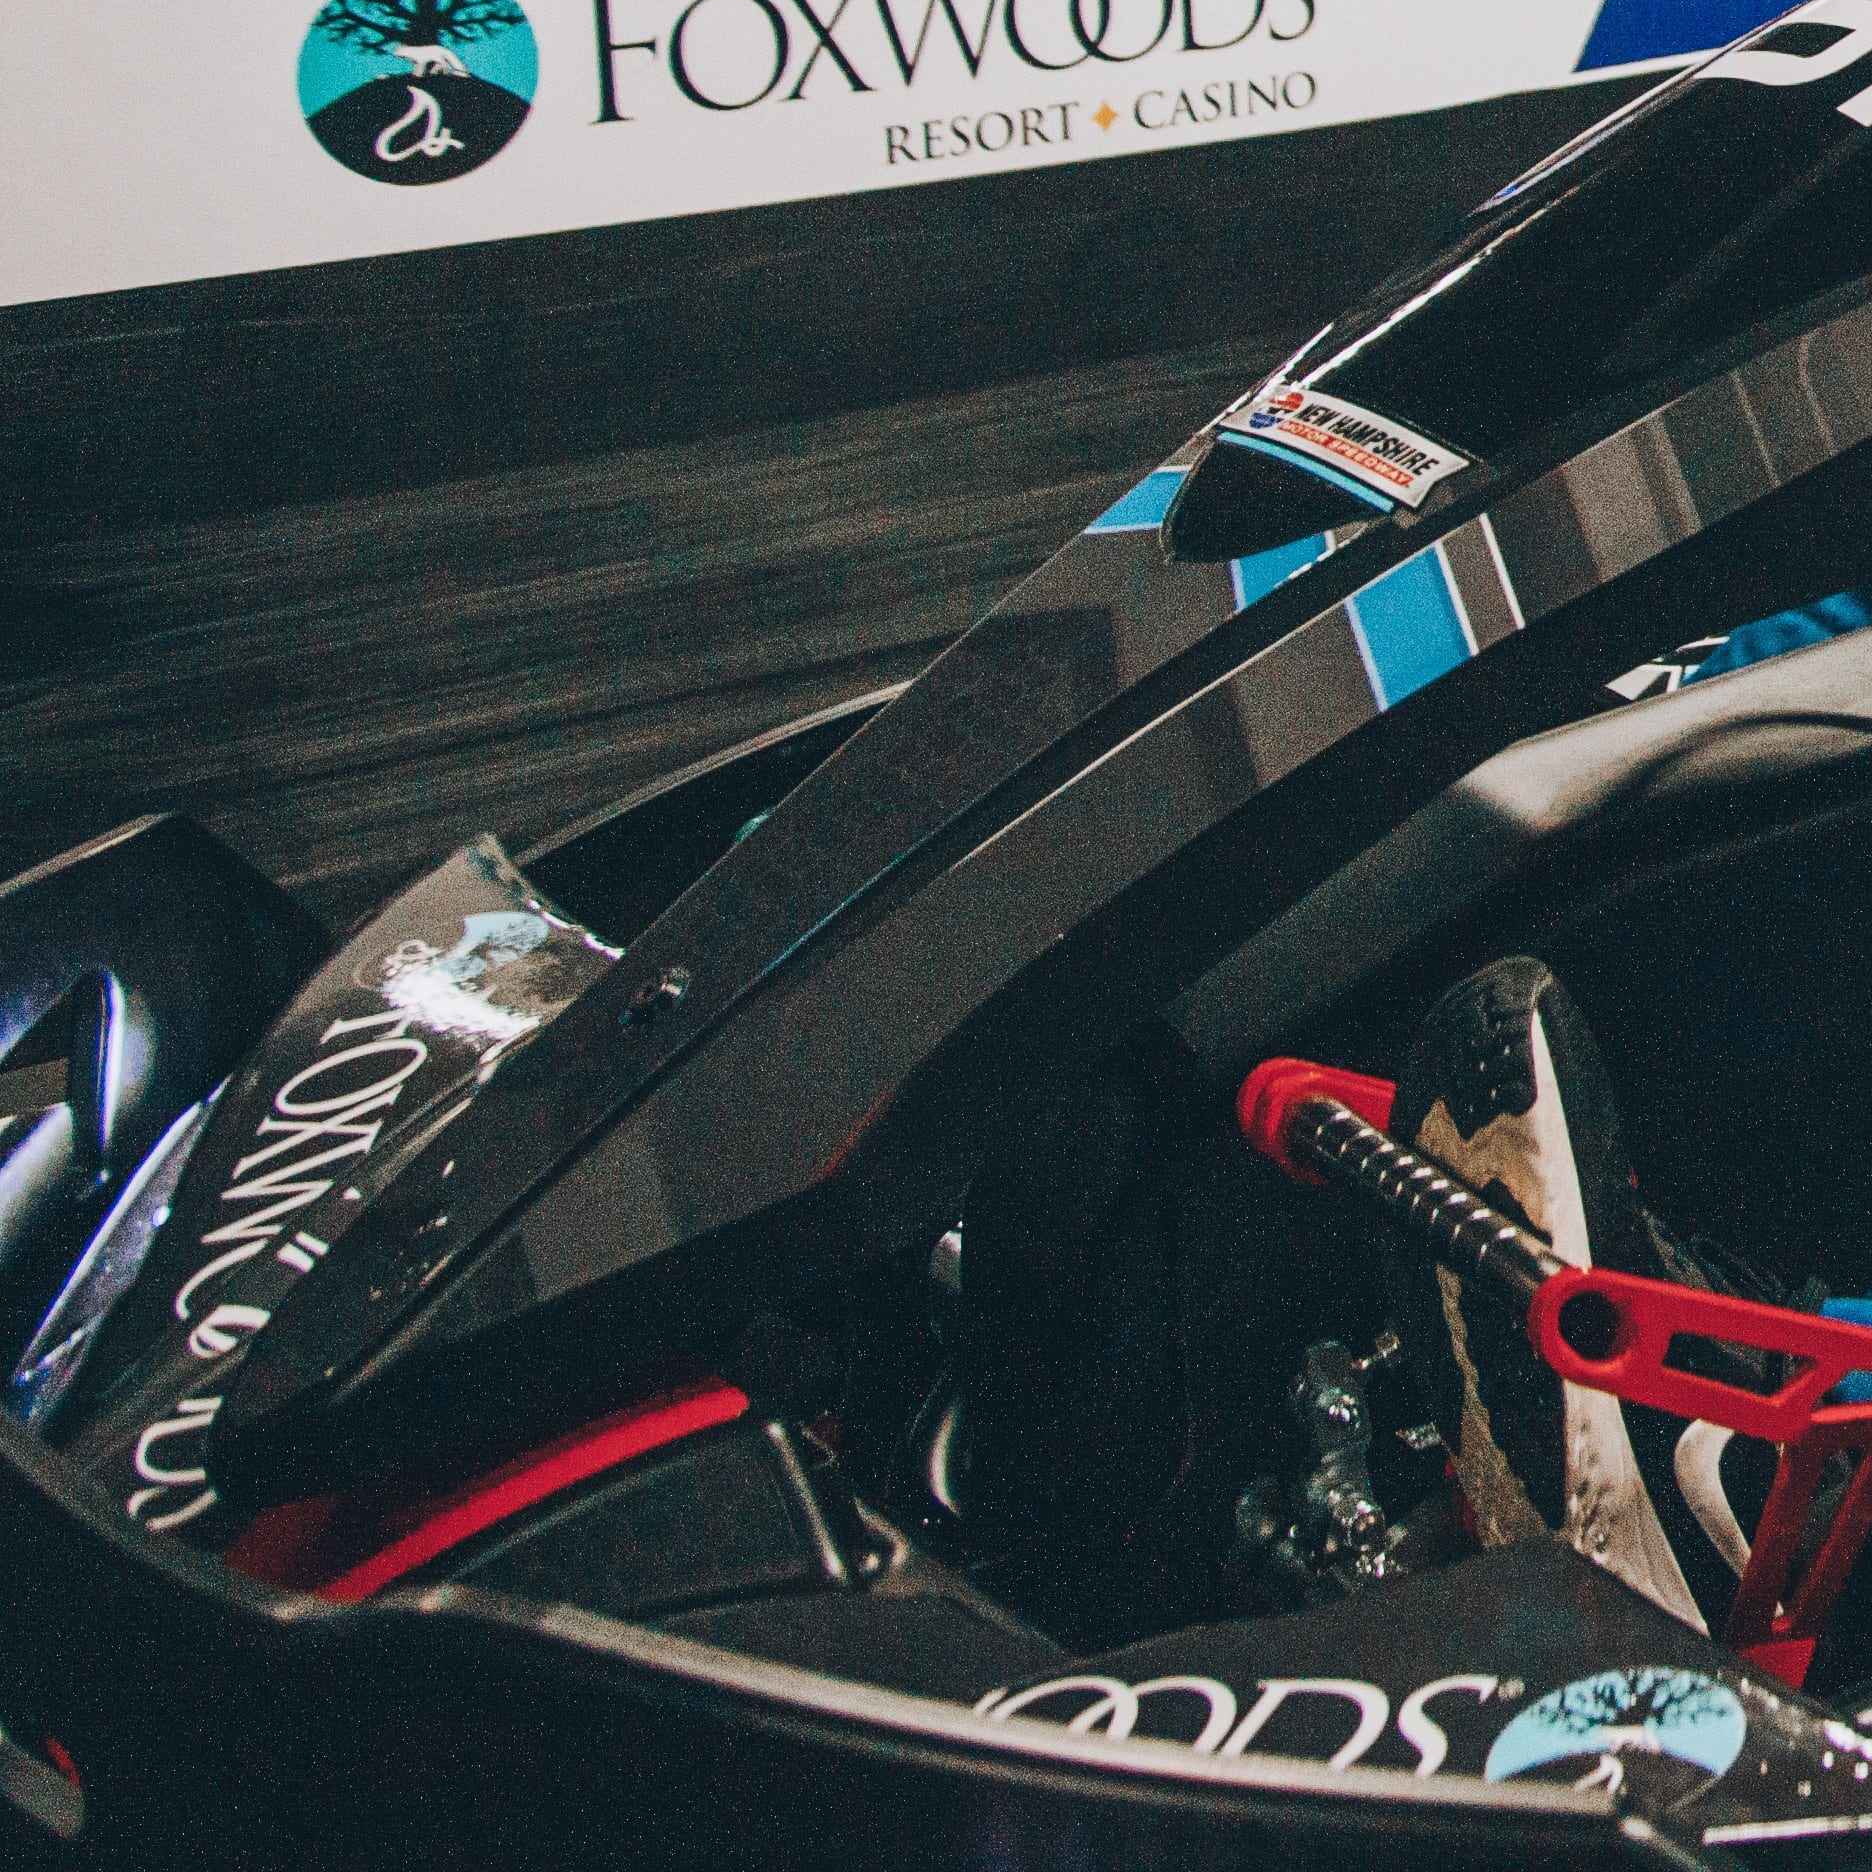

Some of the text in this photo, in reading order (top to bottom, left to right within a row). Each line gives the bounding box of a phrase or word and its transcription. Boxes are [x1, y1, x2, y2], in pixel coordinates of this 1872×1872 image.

[883, 70, 1318, 167] RESORT CASINO
[1296, 402, 1441, 476] NEW HAMPSHIRE
